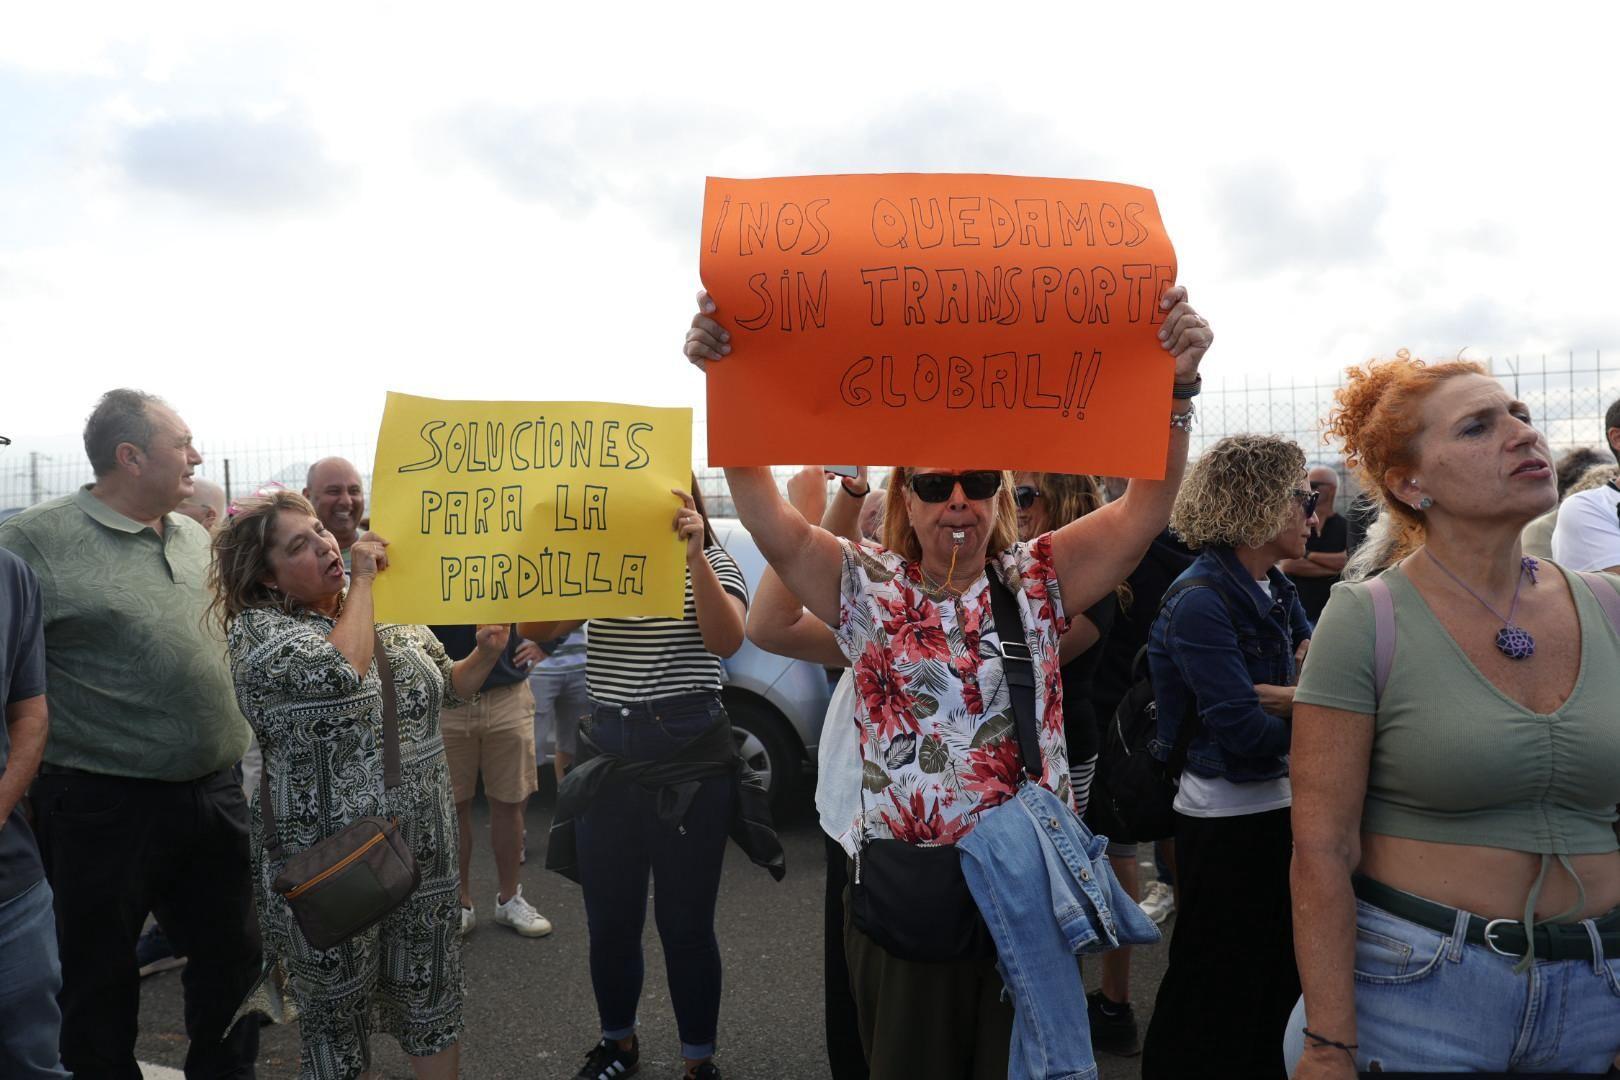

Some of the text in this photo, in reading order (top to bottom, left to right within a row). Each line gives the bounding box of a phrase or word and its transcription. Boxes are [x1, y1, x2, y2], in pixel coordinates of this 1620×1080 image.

[872, 197, 1151, 249] QUEDAMOS
[735, 269, 828, 332] SIN
[840, 348, 1102, 420] GLOBAL!!
[398, 416, 653, 473] SOLUCIONES
[421, 484, 608, 534] PARA LA
[441, 546, 647, 602] PARDILLA
